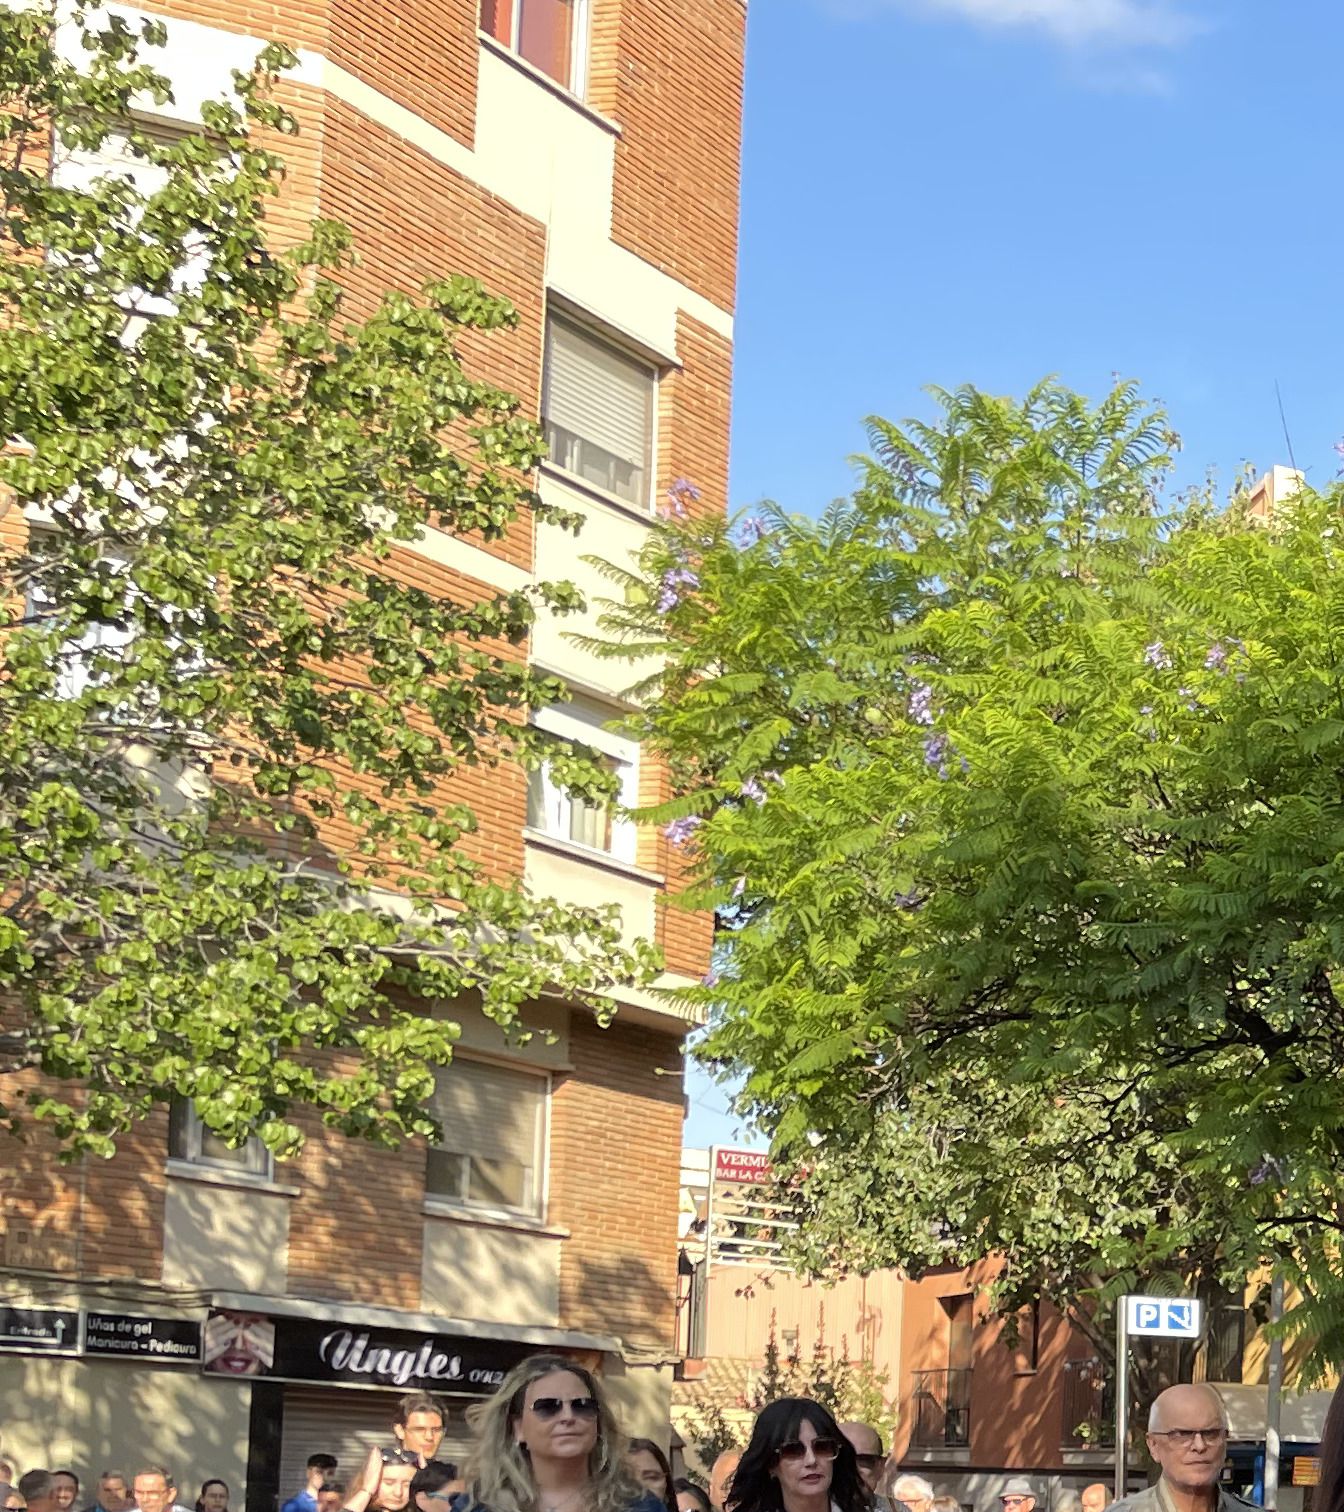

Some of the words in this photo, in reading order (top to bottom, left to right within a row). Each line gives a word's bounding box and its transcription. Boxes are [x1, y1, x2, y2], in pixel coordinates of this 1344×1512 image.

[1140, 1304, 1158, 1328] P
[88, 1318, 115, 1332] Uñas
[117, 1320, 131, 1333] de
[134, 1321, 152, 1337] gel
[87, 1335, 139, 1351] Manicura
[149, 1339, 197, 1355] Pedicura
[319, 1329, 465, 1386] Ungles
